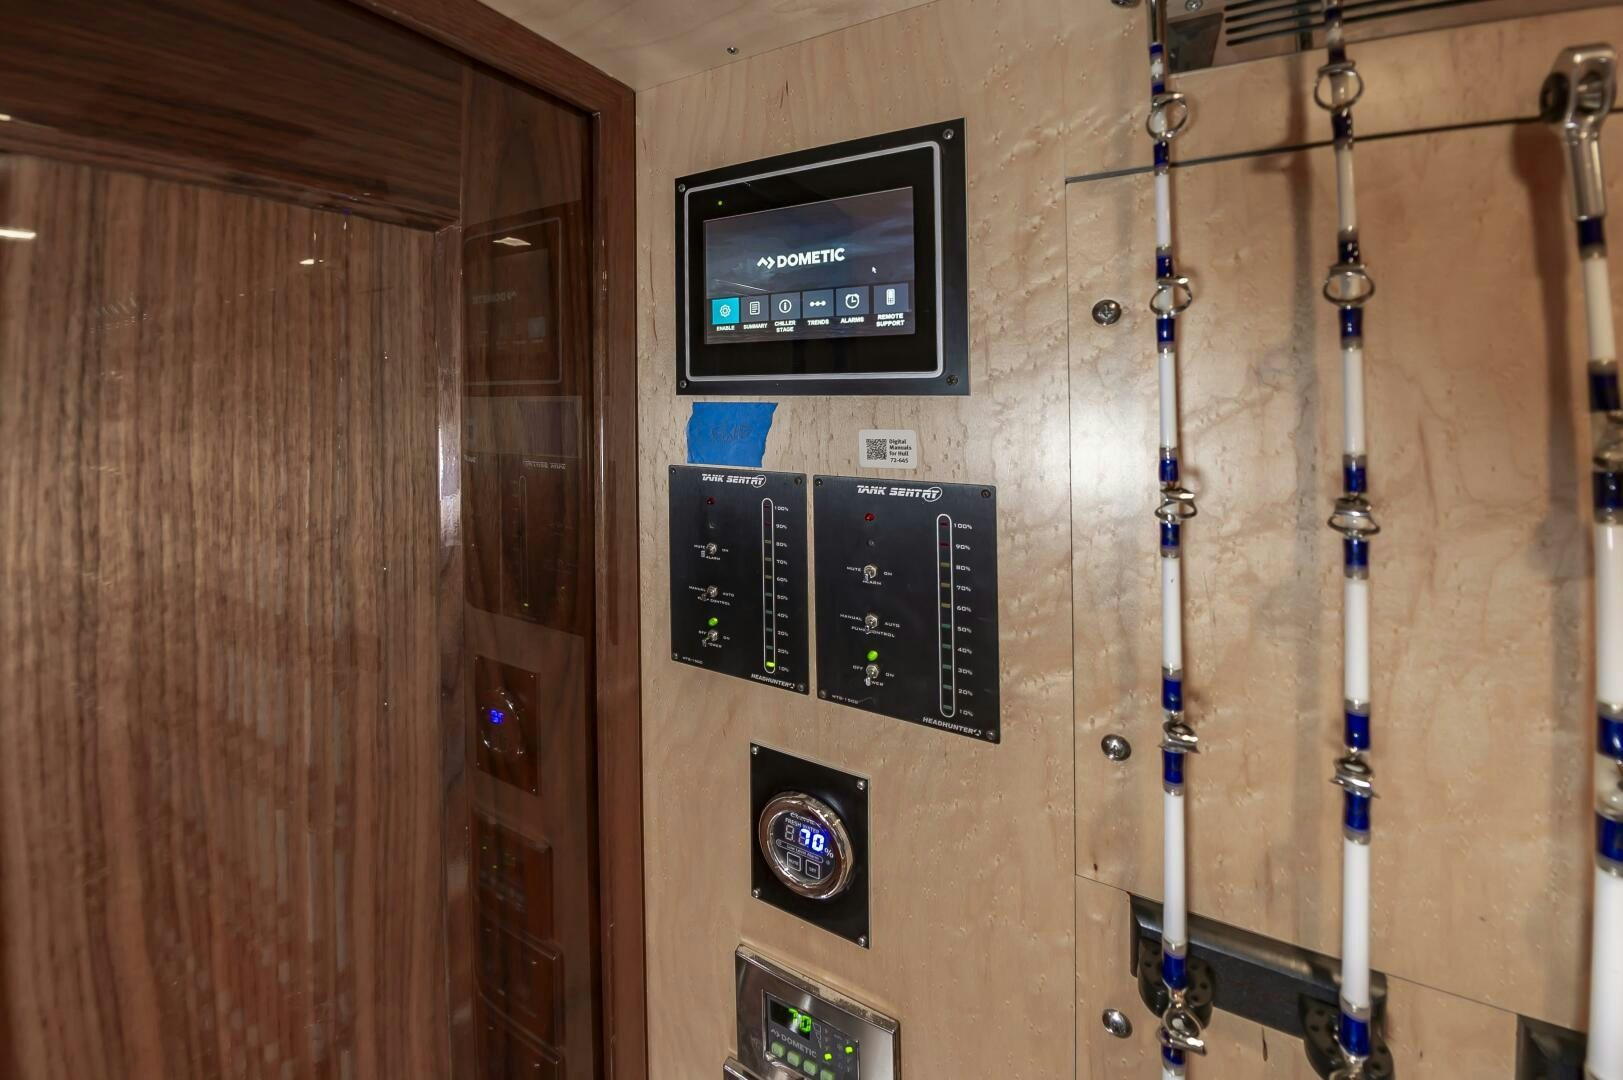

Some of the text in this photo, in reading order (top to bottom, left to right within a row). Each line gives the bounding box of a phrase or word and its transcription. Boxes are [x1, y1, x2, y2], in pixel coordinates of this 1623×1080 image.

[776, 247, 846, 268] DOMETIC
[840, 316, 865, 324] ALARMS
[877, 312, 904, 320] REMOTE
[743, 322, 768, 330] SUMMARY
[774, 319, 796, 327] CHILLER
[807, 318, 830, 326] TRENDS
[876, 319, 906, 327] SUPPORT
[701, 473, 766, 487] TANK SENTRY
[856, 485, 941, 500] TANK SENTRY
[954, 522, 973, 530] 100%
[955, 543, 971, 551] 90%
[955, 564, 971, 572] 80%
[956, 584, 972, 592] 70%
[956, 605, 972, 613] 60%
[956, 626, 972, 634] 50%
[957, 647, 973, 655] 40%
[957, 667, 973, 676] 30%
[750, 673, 791, 688] HEADHUNTER
[958, 688, 974, 697] 20%
[959, 709, 974, 718] 10%
[922, 716, 977, 734] HEADHUNTER
[785, 818, 801, 828] FRESH
[800, 828, 825, 852] 70
[781, 1033, 817, 1058] DOMETIC
